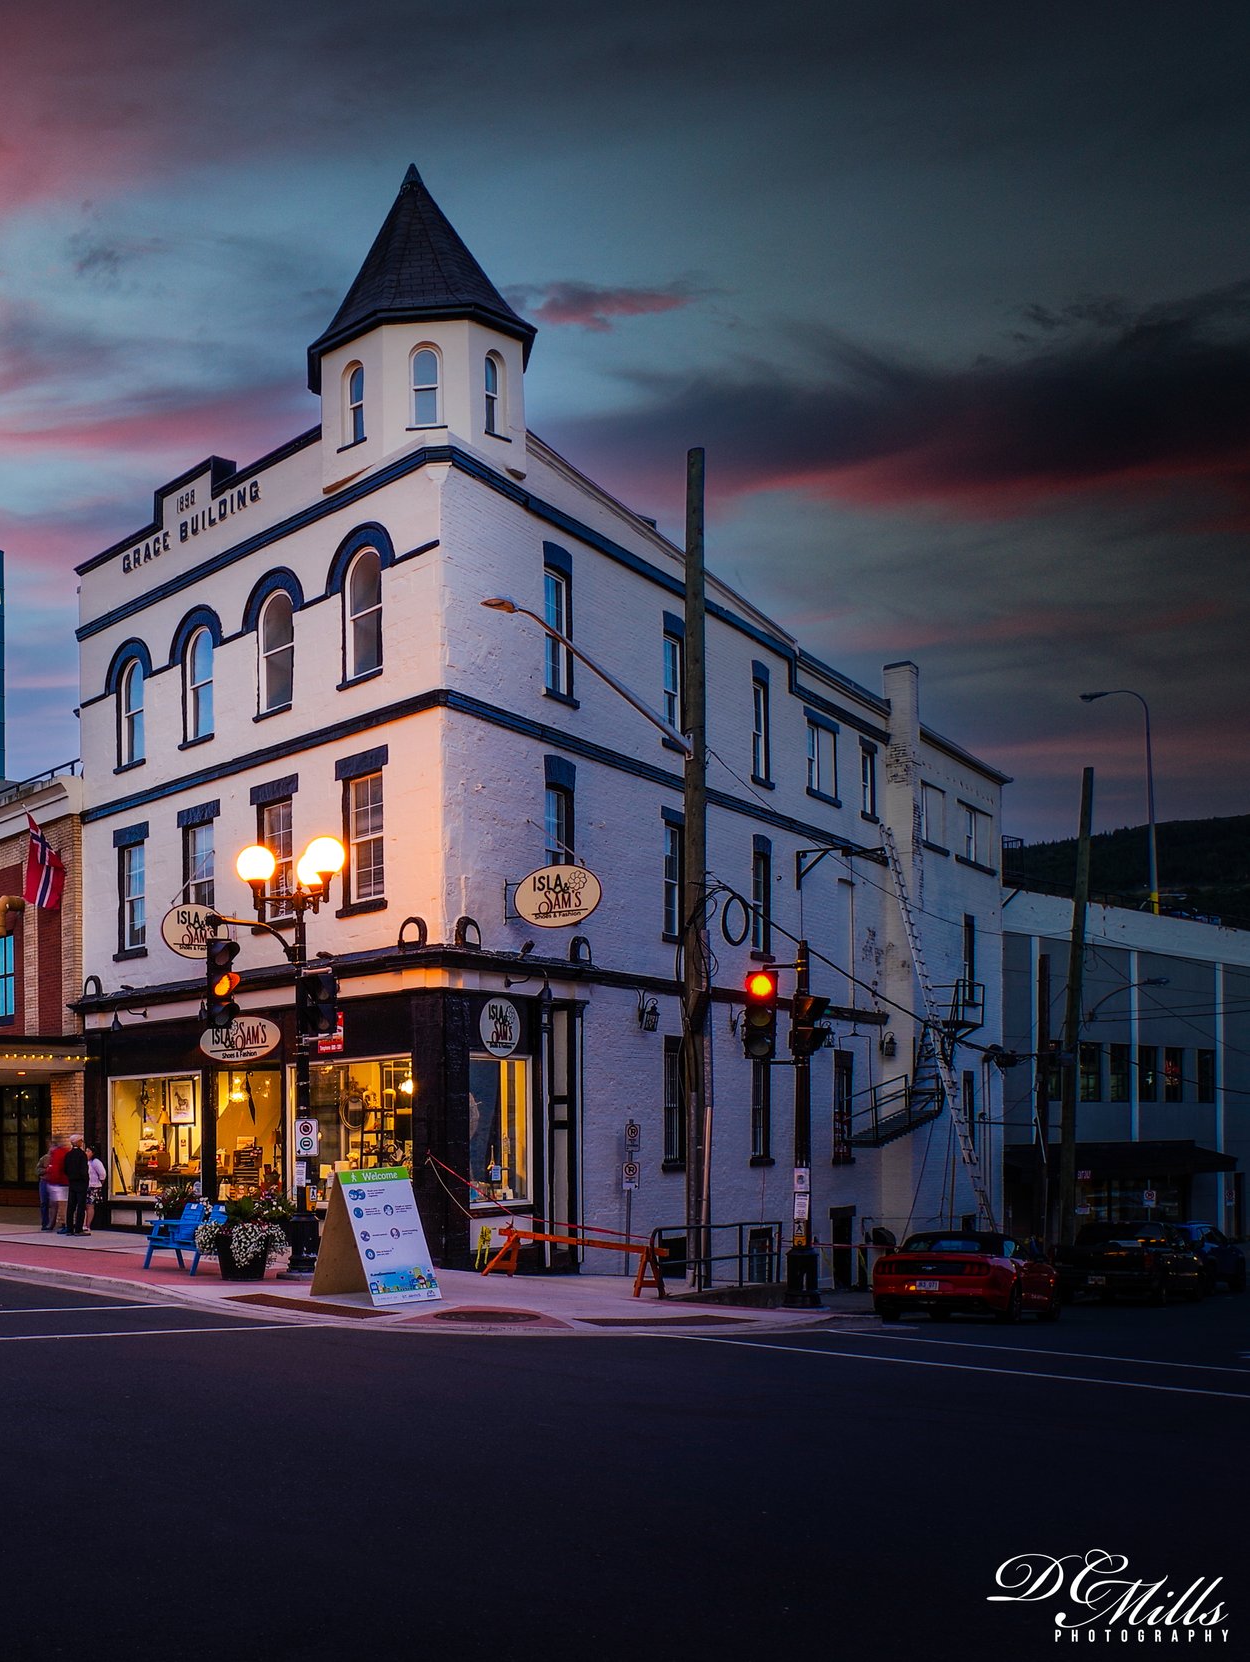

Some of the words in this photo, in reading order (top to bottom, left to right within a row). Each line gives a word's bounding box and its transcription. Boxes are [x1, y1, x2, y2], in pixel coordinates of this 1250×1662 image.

[176, 489, 197, 514] 1898
[122, 530, 171, 574] GRACE
[180, 480, 261, 543] BUILDING
[533, 874, 563, 892] ISLA
[538, 890, 582, 914] SAM'S
[177, 910, 200, 926] ISLA
[236, 1022, 267, 1050] SAM'S
[244, 1050, 258, 1058] Fashion
[362, 1171, 398, 1181] Welcome
